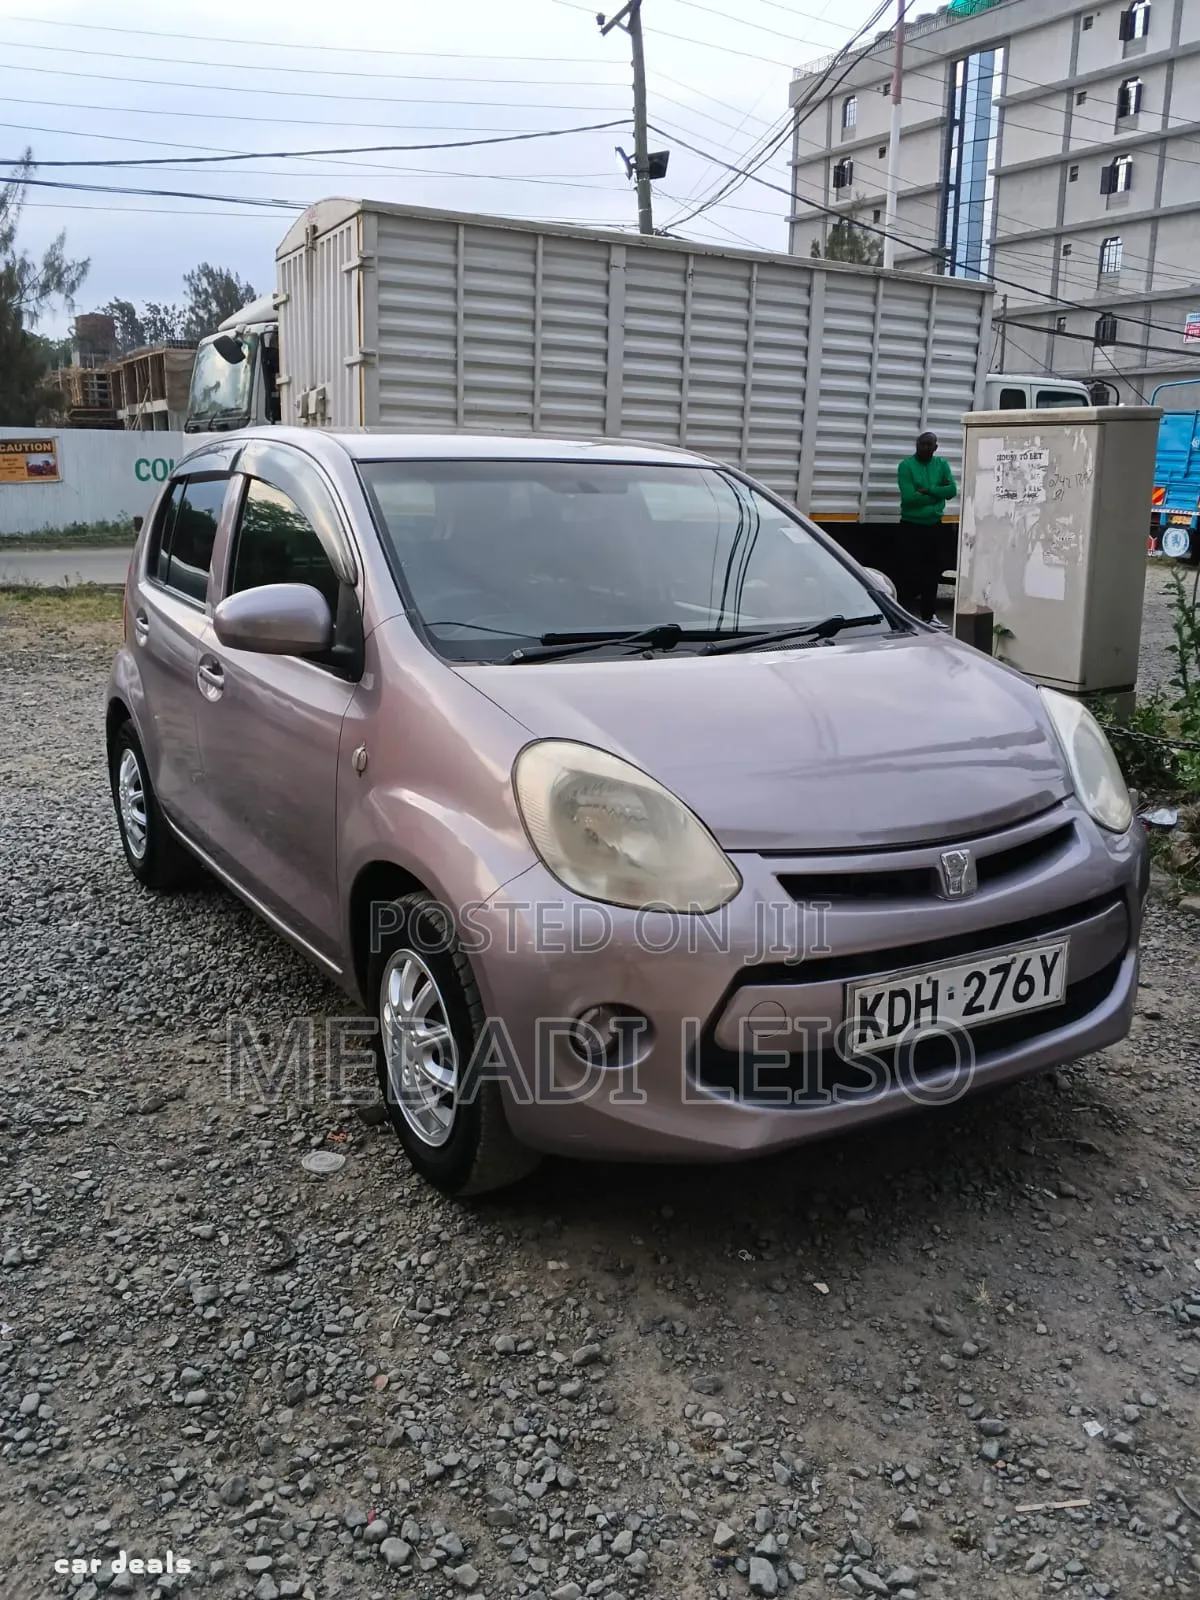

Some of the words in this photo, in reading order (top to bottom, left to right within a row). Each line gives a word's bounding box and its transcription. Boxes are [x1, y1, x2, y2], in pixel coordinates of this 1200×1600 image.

[0, 443, 51, 452] CAUTION
[1030, 452, 1043, 460] LET
[859, 980, 939, 1043] KDH
[962, 951, 1060, 1017] 276Y
